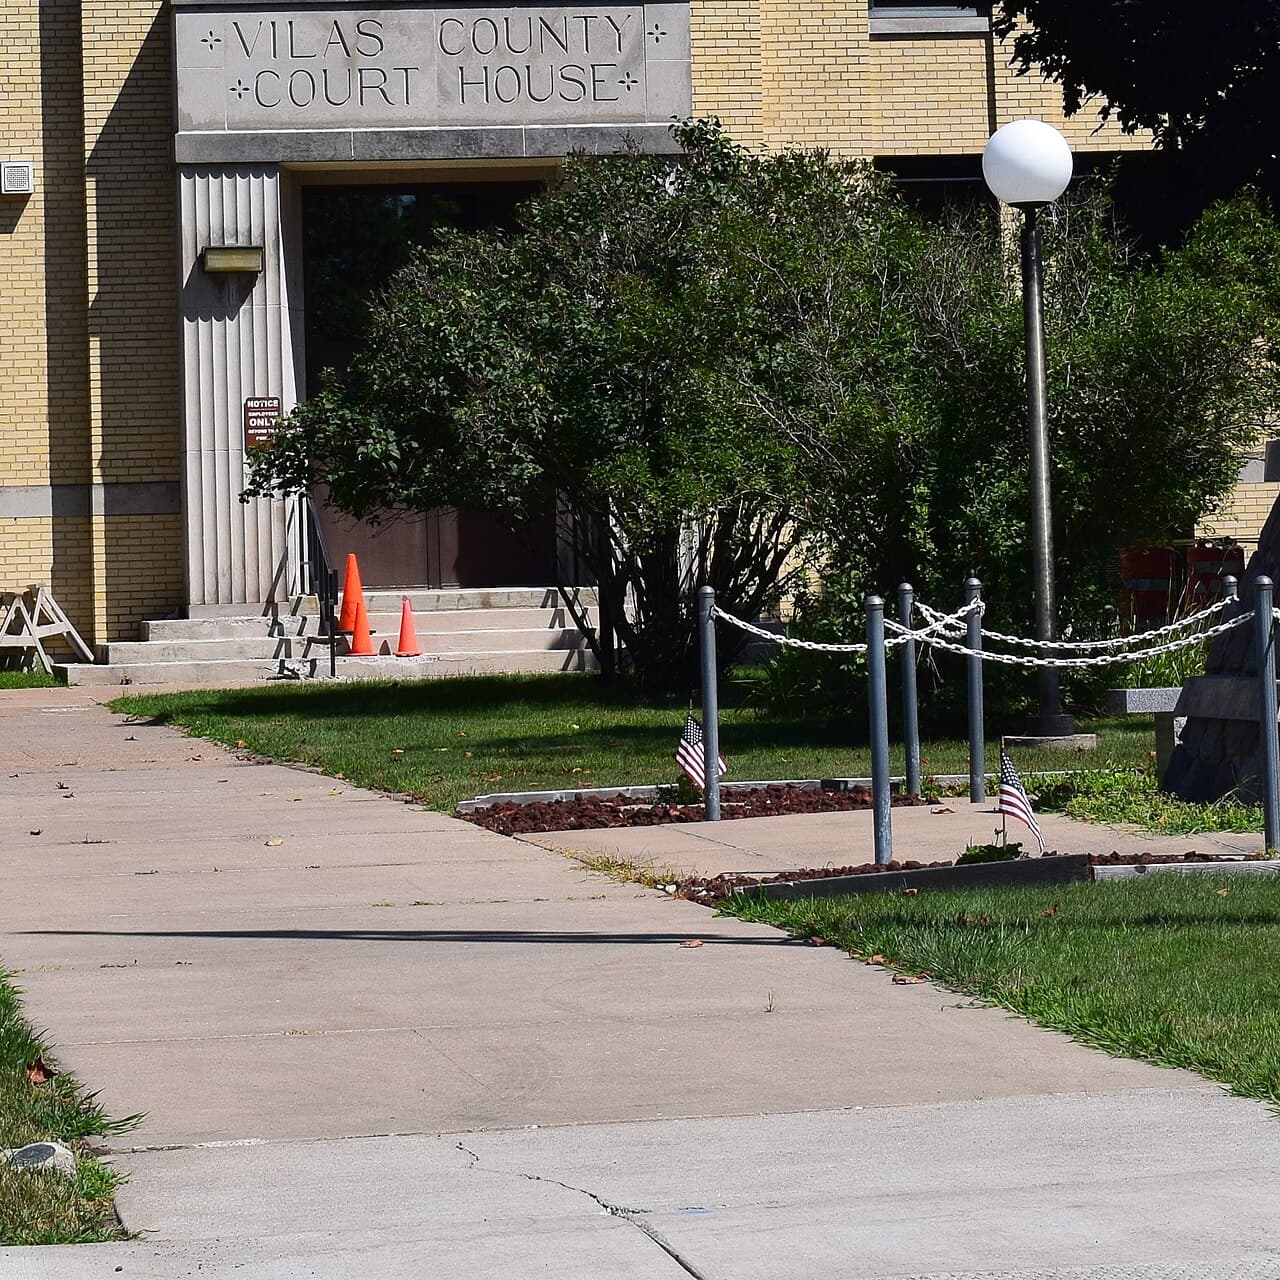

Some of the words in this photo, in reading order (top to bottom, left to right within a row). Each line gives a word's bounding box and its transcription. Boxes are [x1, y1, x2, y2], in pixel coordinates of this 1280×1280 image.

[232, 19, 385, 59] VILAS
[438, 14, 632, 56] COUNTY
[254, 66, 420, 108] COURT
[458, 63, 620, 105] HOUSE
[247, 400, 279, 408] NOTICE
[249, 418, 276, 427] ONLY
